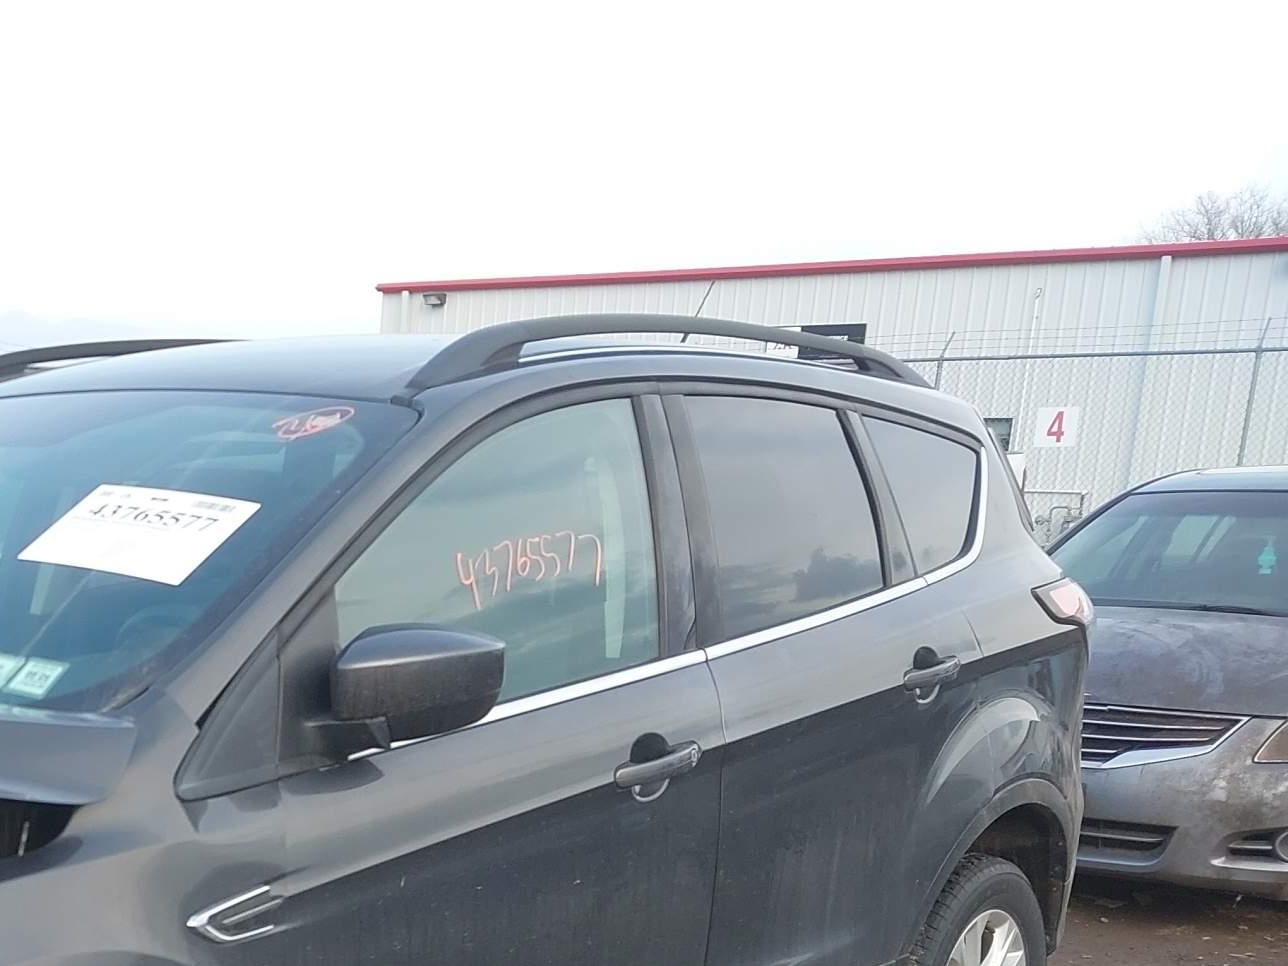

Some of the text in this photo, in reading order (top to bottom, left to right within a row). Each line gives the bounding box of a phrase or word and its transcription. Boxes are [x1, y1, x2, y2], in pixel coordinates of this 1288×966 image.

[1046, 410, 1065, 443] 4
[88, 503, 220, 532] 43765577
[456, 530, 602, 611] 43765577
